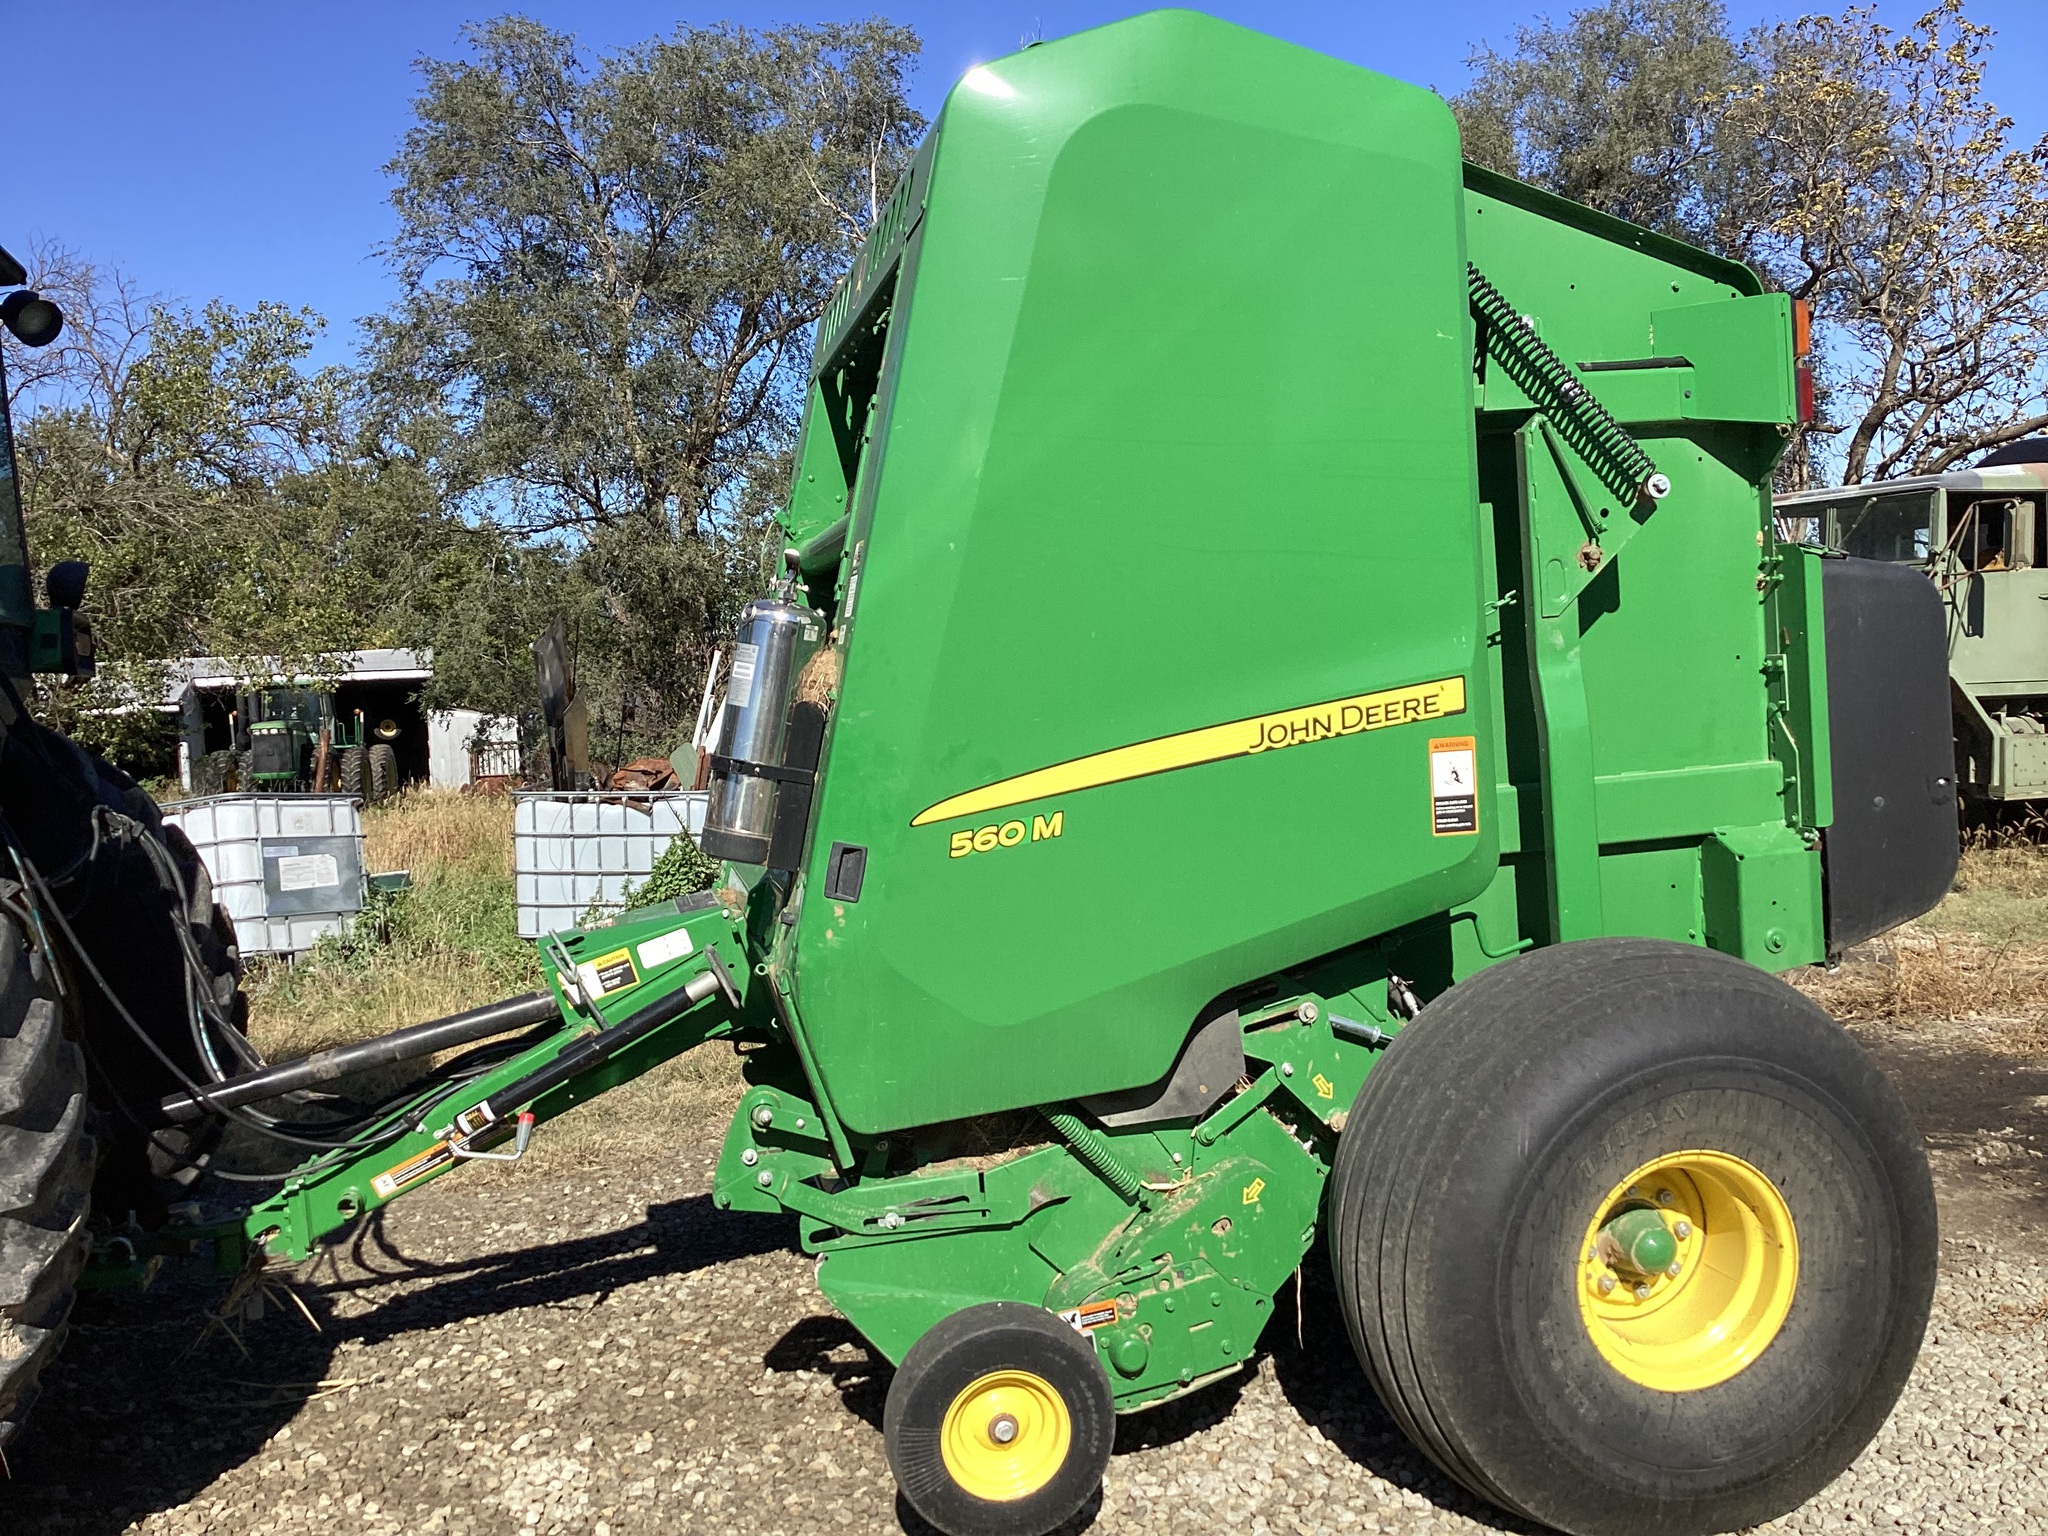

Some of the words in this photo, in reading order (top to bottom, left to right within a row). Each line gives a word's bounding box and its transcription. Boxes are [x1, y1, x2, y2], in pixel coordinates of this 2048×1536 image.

[1249, 714, 1332, 750] JOHN
[1341, 693, 1440, 731] DEERE
[949, 820, 1027, 858] 560
[1031, 810, 1064, 842] M
[602, 953, 625, 964] CAUTION
